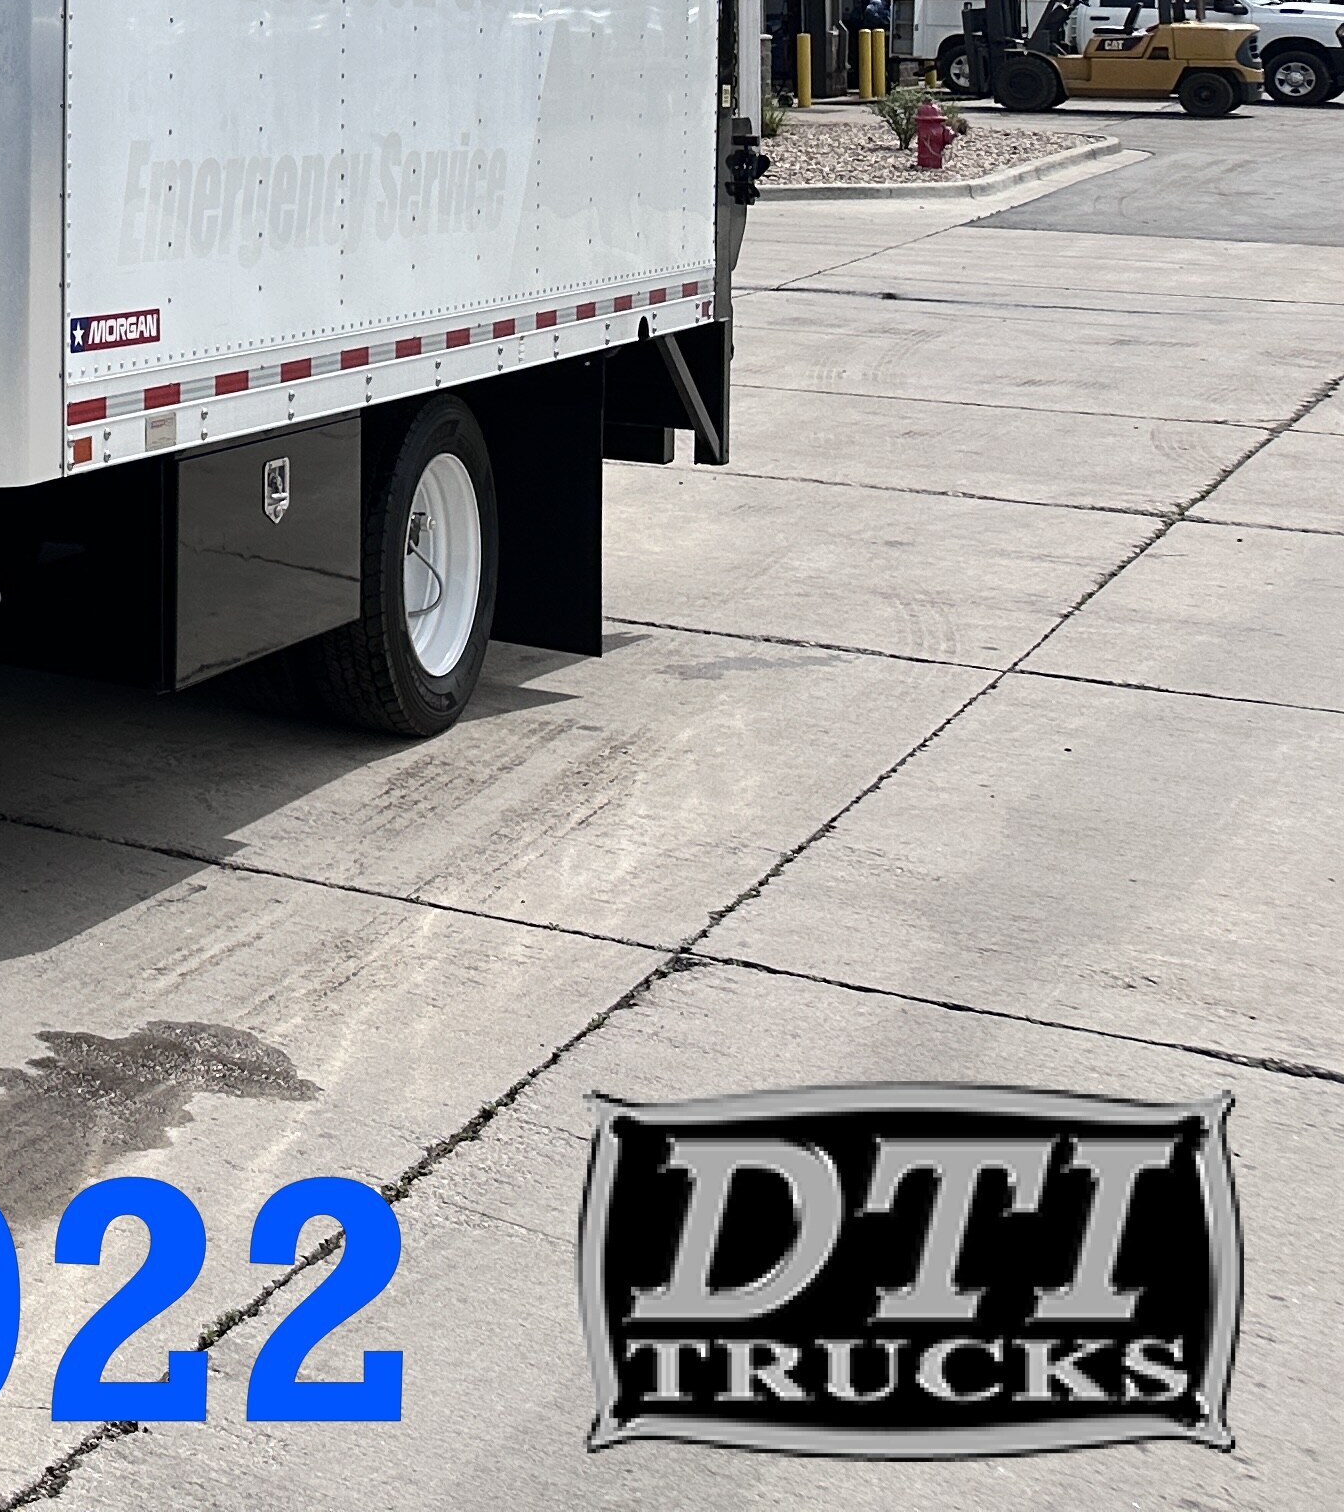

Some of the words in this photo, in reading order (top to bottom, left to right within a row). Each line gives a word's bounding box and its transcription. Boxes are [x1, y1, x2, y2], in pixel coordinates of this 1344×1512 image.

[1104, 40, 1125, 50] CAT
[117, 139, 373, 270] Emergency
[375, 131, 508, 242] Service
[88, 313, 158, 345] MORGAN
